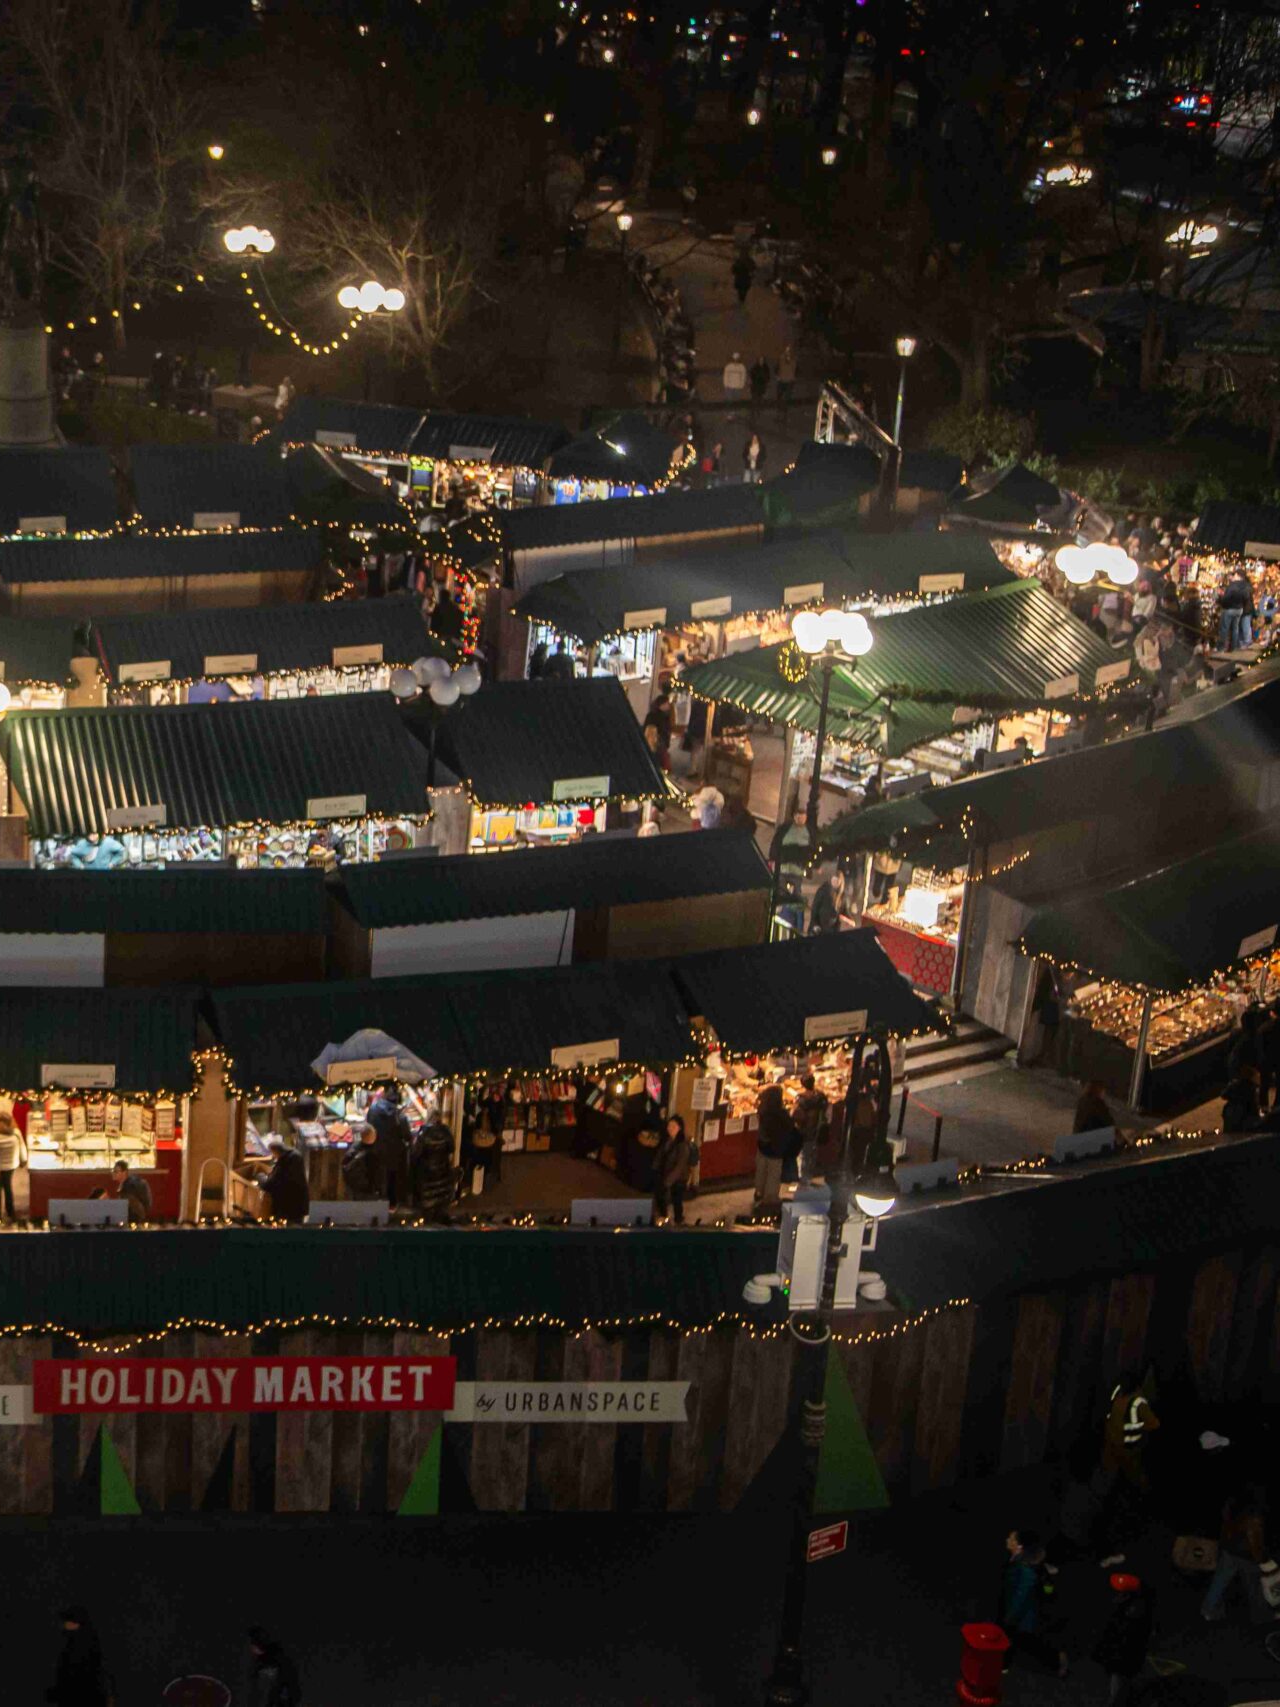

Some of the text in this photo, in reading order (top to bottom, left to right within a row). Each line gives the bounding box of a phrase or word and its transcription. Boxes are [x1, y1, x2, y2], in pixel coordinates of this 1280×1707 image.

[59, 1364, 433, 1405] HOLIDAY MARKET
[476, 1391, 661, 1413] by URBANSPACE
